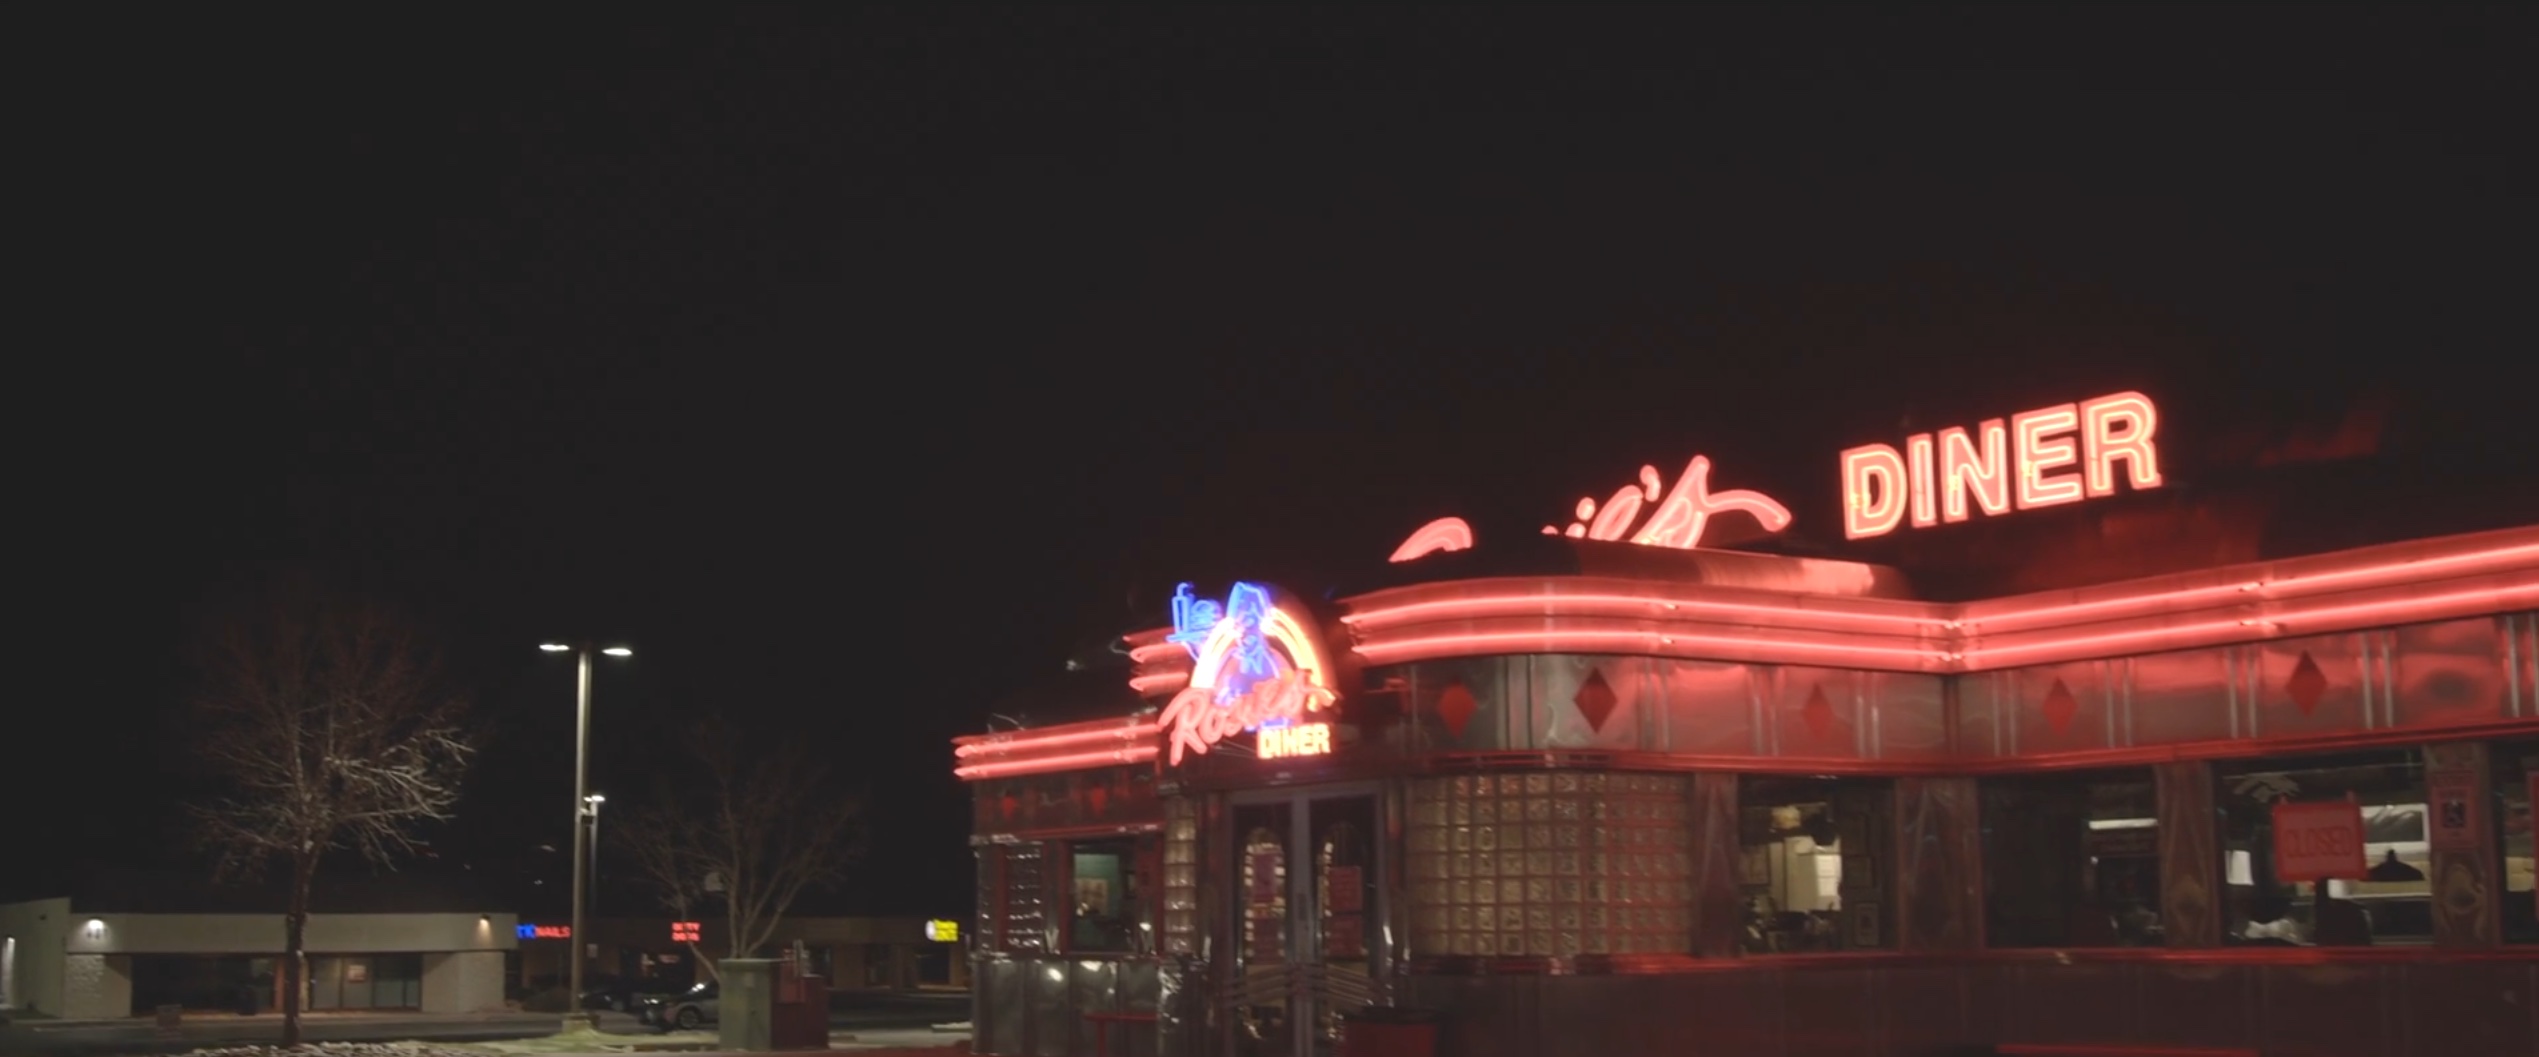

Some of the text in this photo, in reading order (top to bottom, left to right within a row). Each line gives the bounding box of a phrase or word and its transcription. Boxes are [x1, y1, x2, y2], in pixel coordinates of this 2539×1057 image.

[1840, 391, 2162, 540] DINER
[1257, 723, 1331, 759] DINER
[2285, 826, 2352, 857] CLOSED
